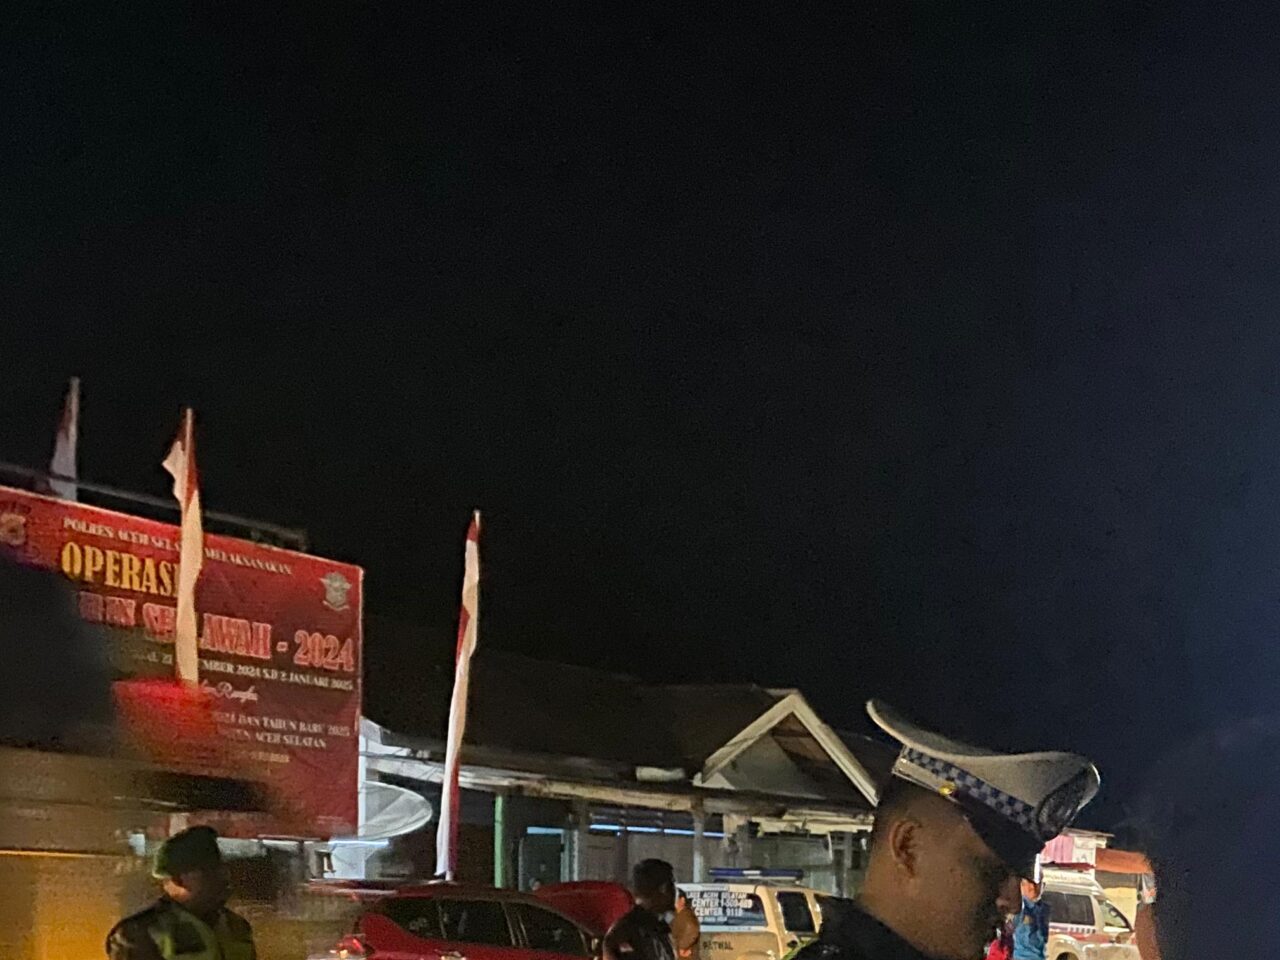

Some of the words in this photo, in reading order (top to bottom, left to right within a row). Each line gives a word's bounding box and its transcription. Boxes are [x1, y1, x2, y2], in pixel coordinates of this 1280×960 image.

[118, 529, 149, 545] ACEH
[294, 629, 355, 672] 2024
[288, 673, 330, 688] JANUARI
[283, 735, 327, 749] SELATAN
